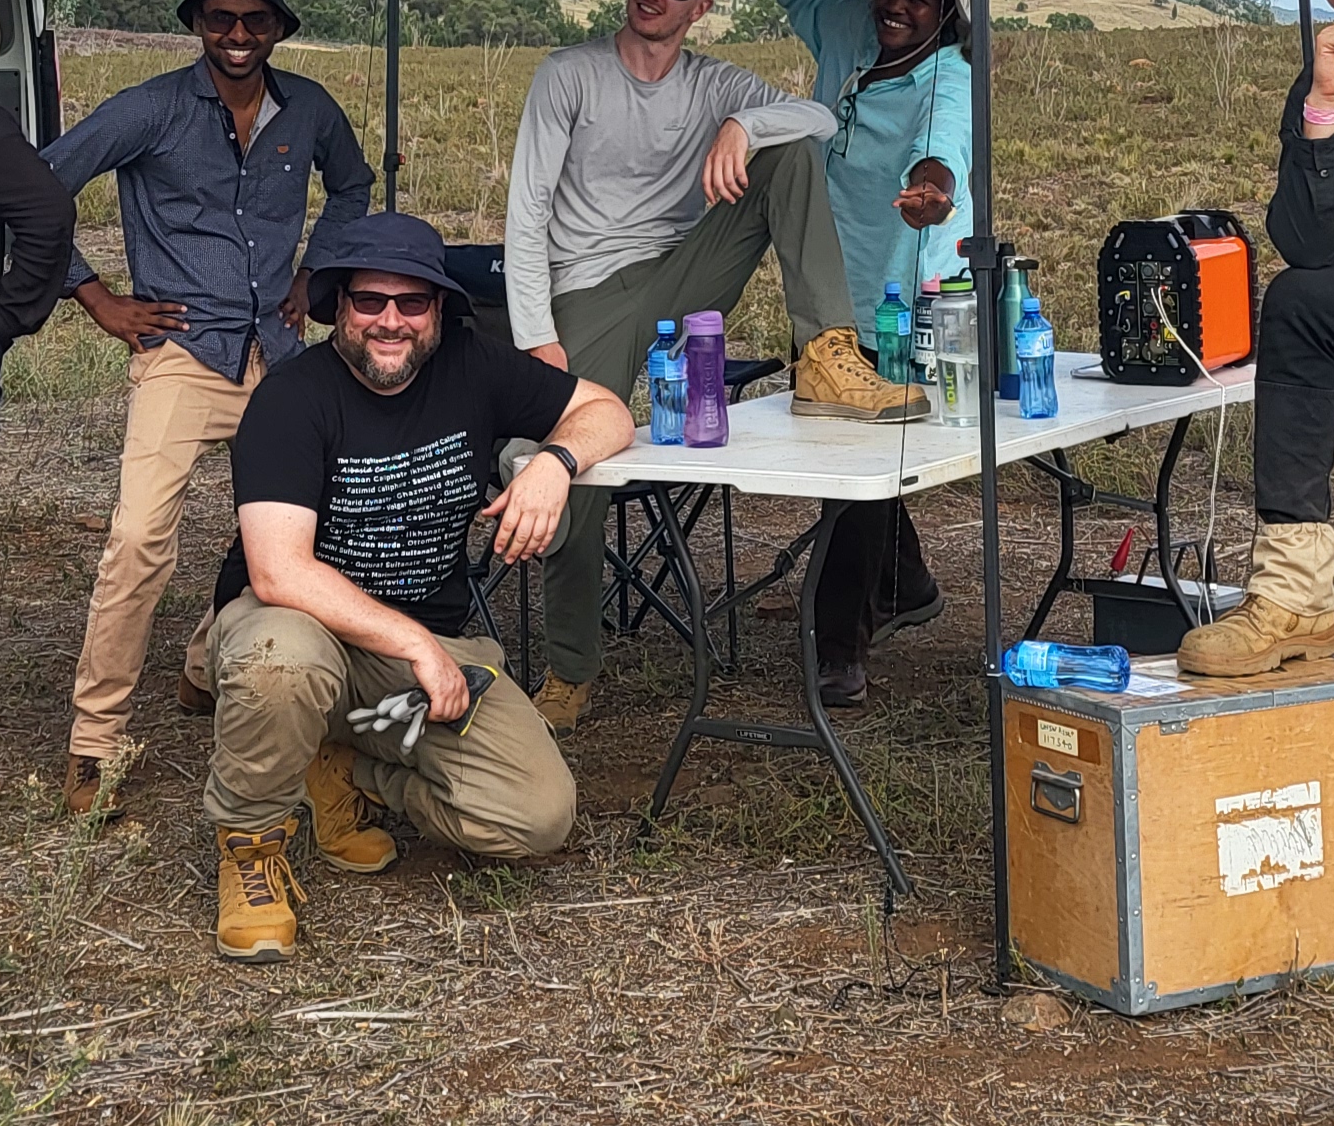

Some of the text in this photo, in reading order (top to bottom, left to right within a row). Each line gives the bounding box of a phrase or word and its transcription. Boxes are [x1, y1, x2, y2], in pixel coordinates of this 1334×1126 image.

[332, 497, 363, 506] Saffarid
[396, 482, 442, 499] Ghaznavid
[445, 474, 472, 487] dynasty
[347, 486, 376, 494] Fatimid
[406, 528, 445, 538] Ilkhanate
[347, 539, 376, 548] Golden
[319, 542, 338, 552] Delhi
[339, 547, 373, 558] Sultanate
[401, 547, 437, 556] Sultanate
[408, 576, 437, 585] Empire
